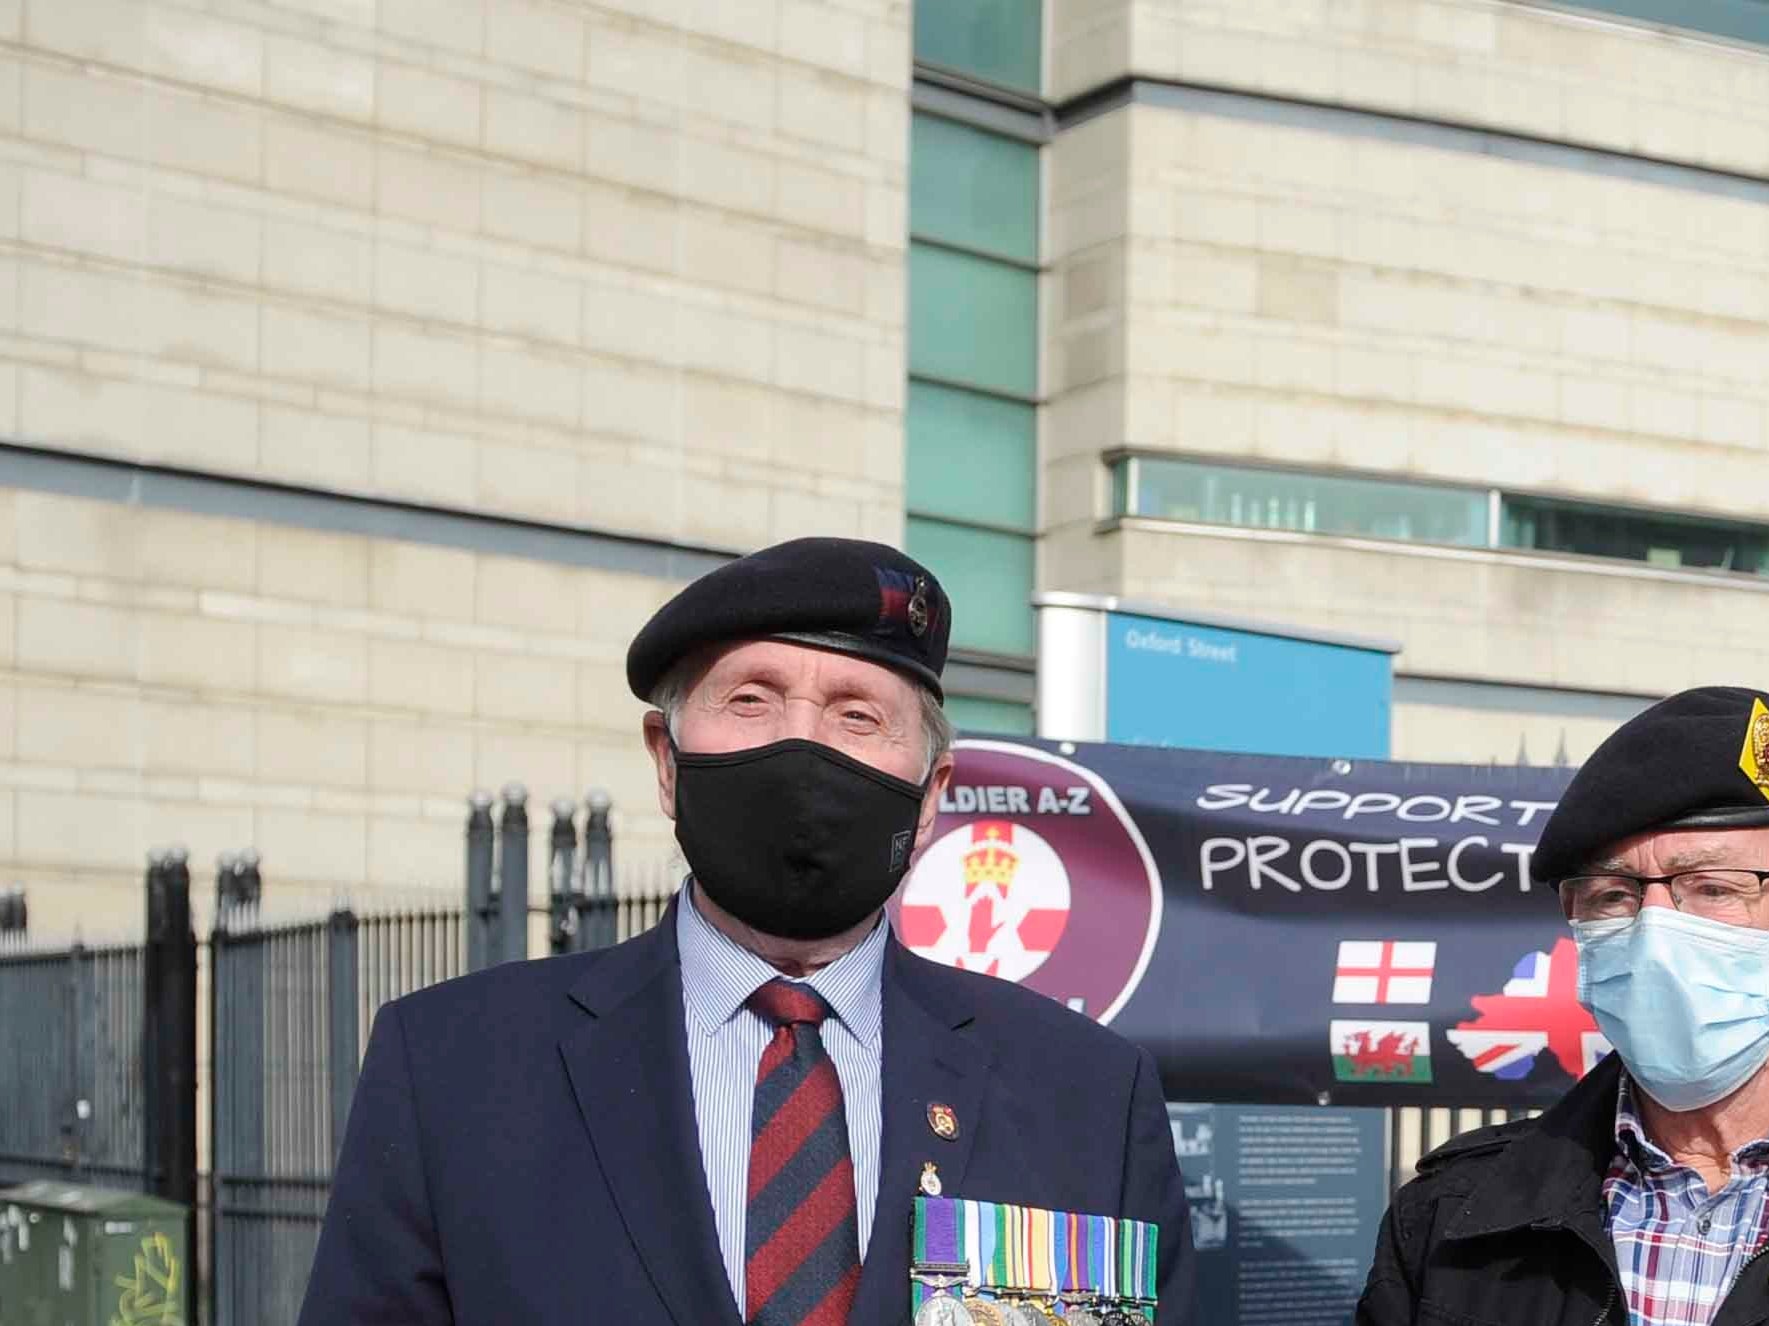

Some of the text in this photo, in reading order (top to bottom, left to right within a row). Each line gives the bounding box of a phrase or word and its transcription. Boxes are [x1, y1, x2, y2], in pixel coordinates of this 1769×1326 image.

[1125, 628, 1238, 664] Oxford Street
[939, 785, 1091, 815] LDIER A-Z
[1200, 835, 1537, 893] PROTECT
